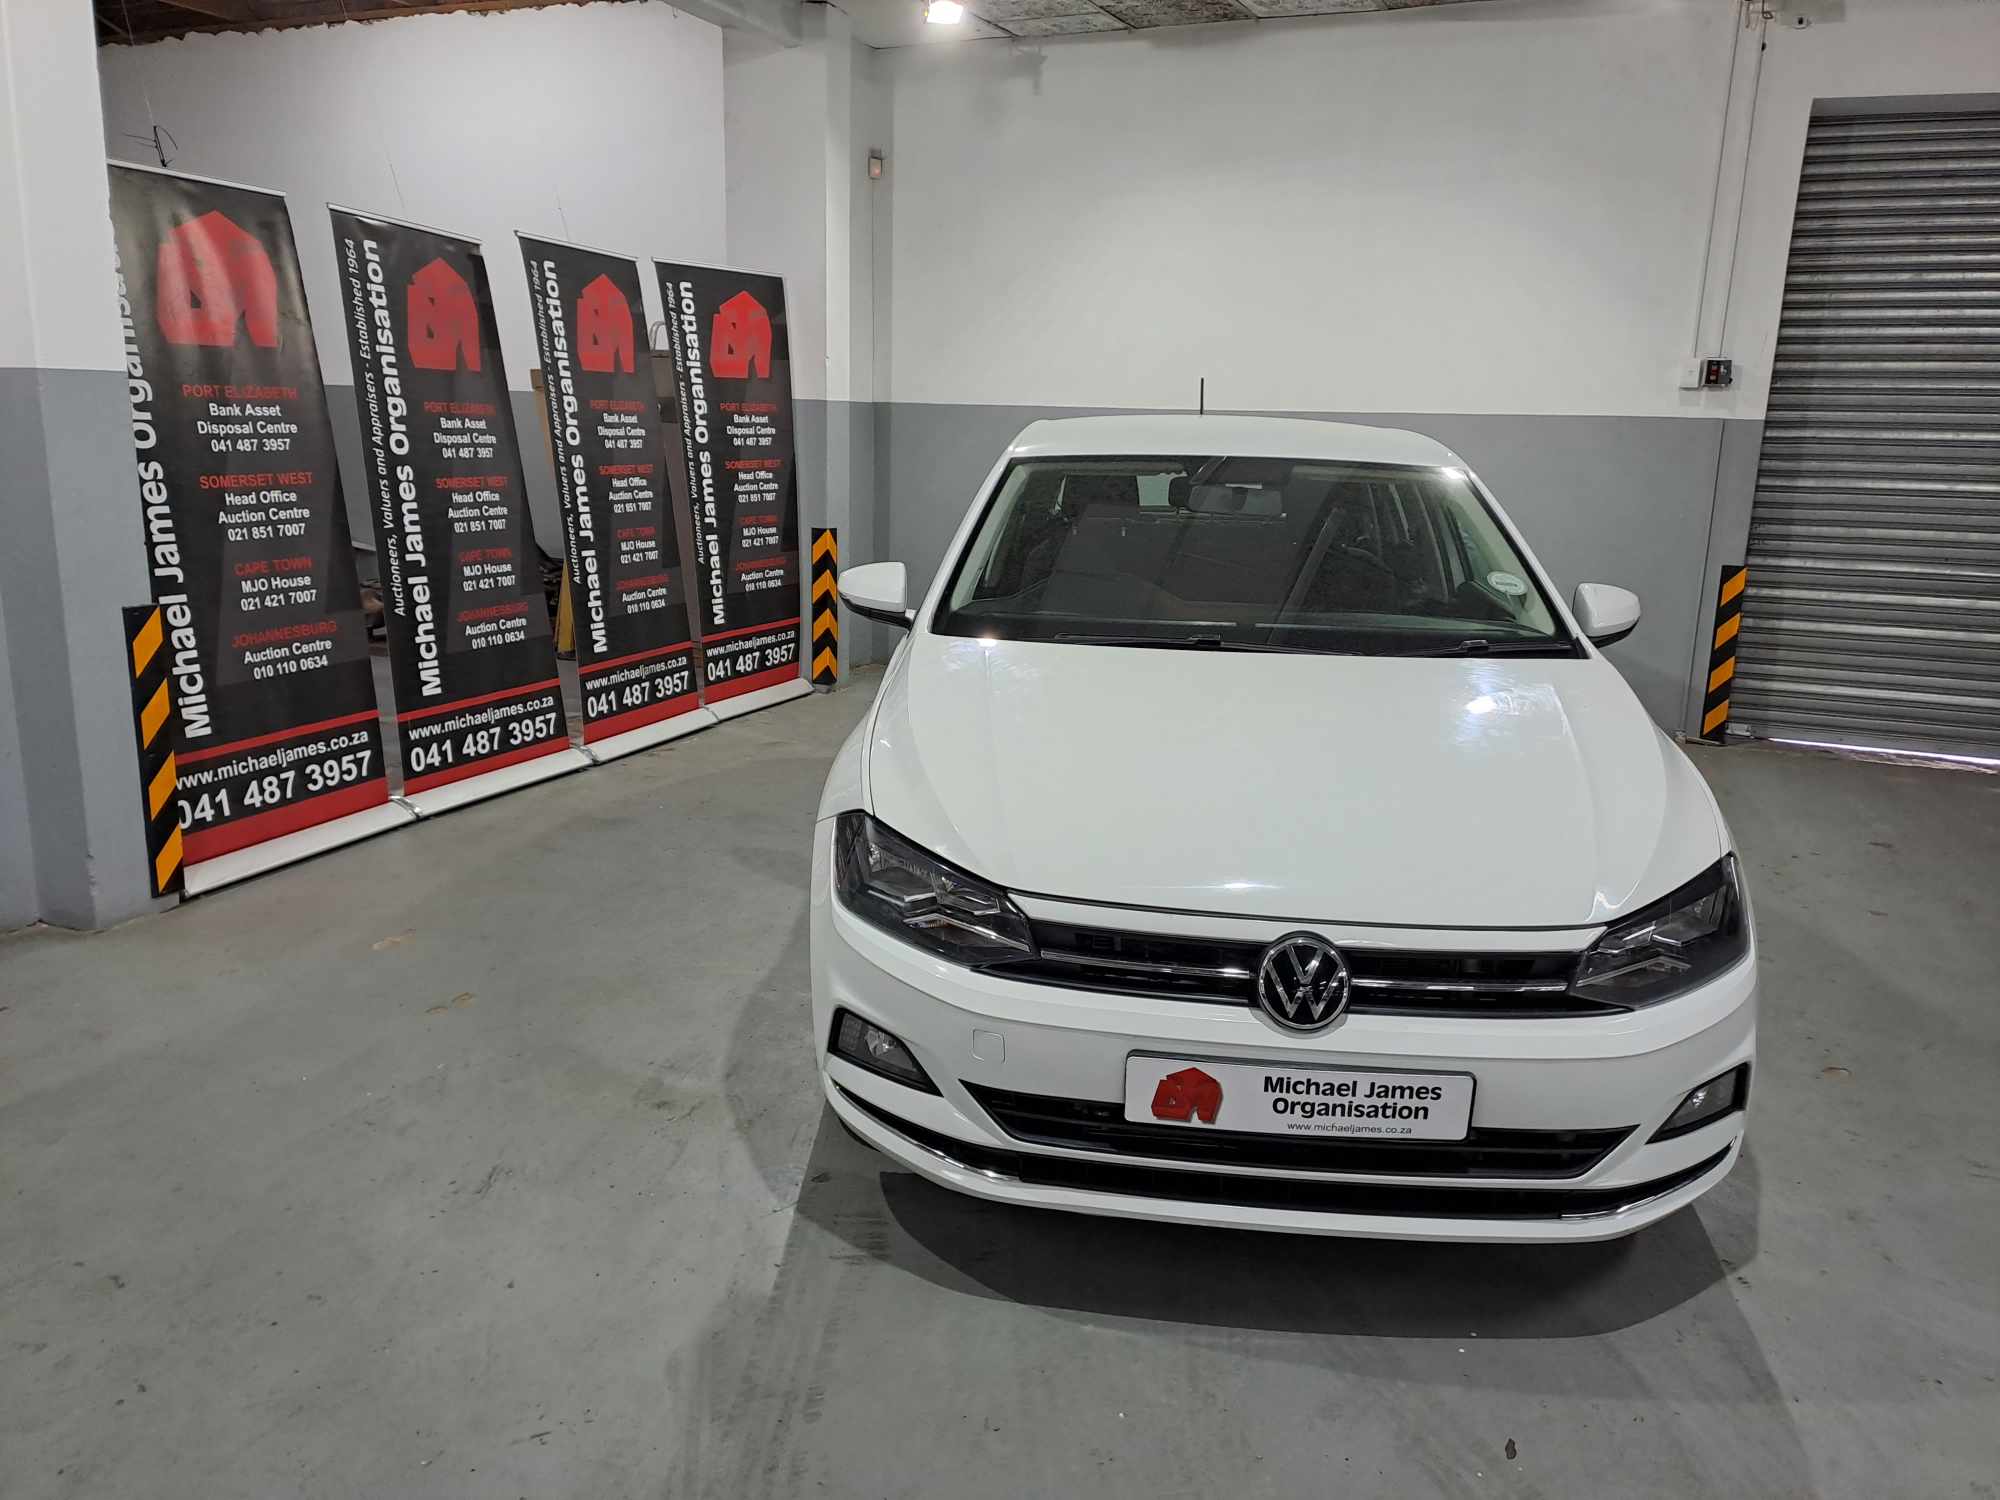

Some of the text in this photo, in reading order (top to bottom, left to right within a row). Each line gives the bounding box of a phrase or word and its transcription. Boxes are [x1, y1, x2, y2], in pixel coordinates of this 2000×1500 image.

[666, 282, 678, 309] 1964
[668, 312, 683, 372] Established
[182, 384, 222, 398] PORT
[209, 403, 281, 416] Bank Asset
[679, 381, 691, 436] Appraisers
[197, 421, 298, 436] Disposal Centre
[344, 238, 405, 616] Auctioneers, Valuers and Appraisers Established 1964
[440, 418, 486, 429] Bank Asset
[530, 260, 581, 584] Auctioneers, Valuers and Appraisers Established 1964
[211, 439, 290, 452] 041 487 3957
[433, 433, 496, 445] Disposal Centre
[685, 437, 694, 458] and
[442, 448, 493, 458] 041 487 3957
[543, 260, 608, 654] Michael James Organisation
[679, 281, 725, 625] Michael James Organisation
[363, 239, 443, 697] Michael James Organisation
[200, 472, 313, 488] SOMERSET WEST
[688, 462, 698, 498] Valuers
[225, 490, 297, 506] Head Office
[452, 491, 500, 503] Head Office
[137, 460, 184, 584] James
[218, 507, 310, 524] Auction Centre
[448, 505, 508, 519] Auction Centre
[228, 523, 306, 541] 021 851 7007
[454, 519, 506, 533] 021 851 7007
[234, 557, 312, 577] CAPE TOWN
[463, 563, 512, 577] MJO House
[241, 575, 311, 594] MJO House
[463, 575, 516, 592] 021 421 7007
[240, 589, 317, 612] 021 421 7007
[465, 618, 527, 636] Auction Centre
[472, 631, 525, 650] 010 110 0634
[244, 639, 332, 665] Auction Centre
[708, 643, 795, 681] 041 487 3957
[159, 594, 212, 739] Michael
[253, 655, 328, 680] 010 110 0634
[585, 655, 687, 690] www.michaeljames.co.za
[587, 671, 689, 718] 041 487 3957
[408, 695, 554, 741] www.michaeljames.co.za
[410, 712, 557, 772] 041 487 3957
[177, 750, 372, 830] 041 487 3957
[1263, 1076, 1442, 1101] Michael James
[1272, 1097, 1429, 1120] Organisation
[1287, 1122, 1412, 1135] www.michaeljames.co.za
